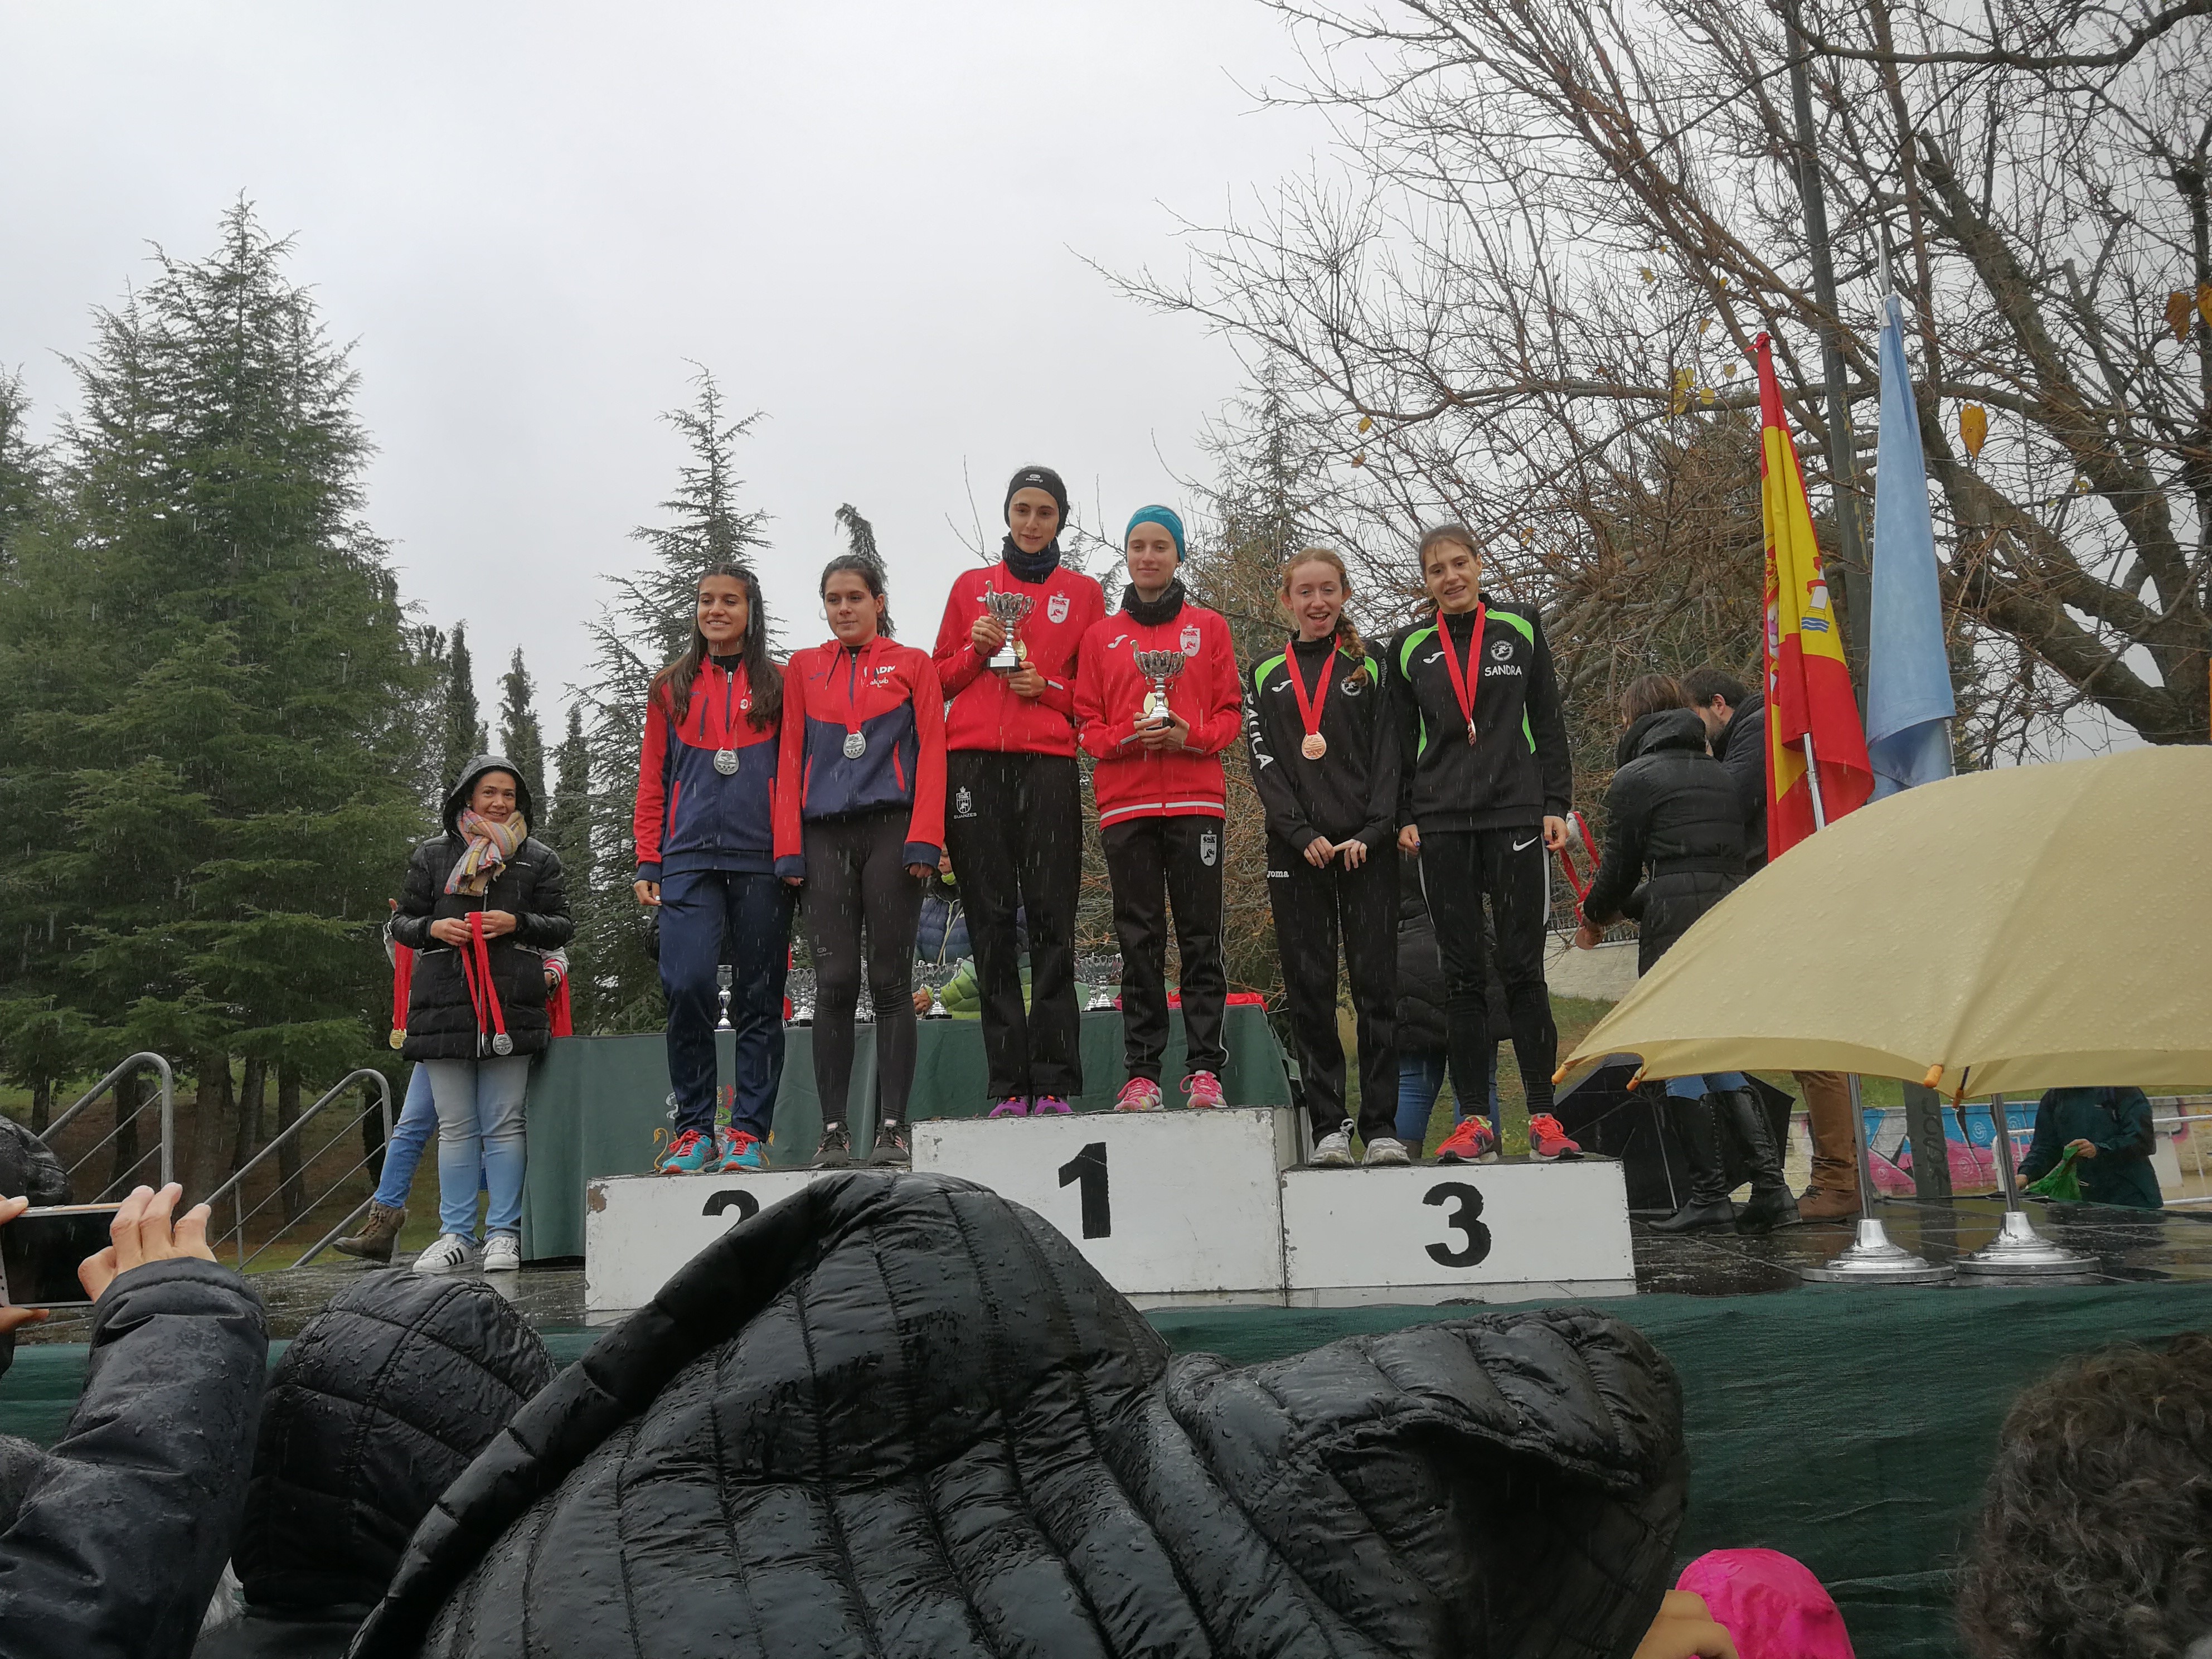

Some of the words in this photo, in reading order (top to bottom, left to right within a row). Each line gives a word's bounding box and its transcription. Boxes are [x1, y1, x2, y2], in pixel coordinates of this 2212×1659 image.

[1485, 664, 1522, 677] SANDRA
[1246, 691, 1274, 770] PAULA
[702, 1190, 759, 1236] 2
[1058, 1142, 1111, 1239] 1
[1422, 1181, 1492, 1268] 3
